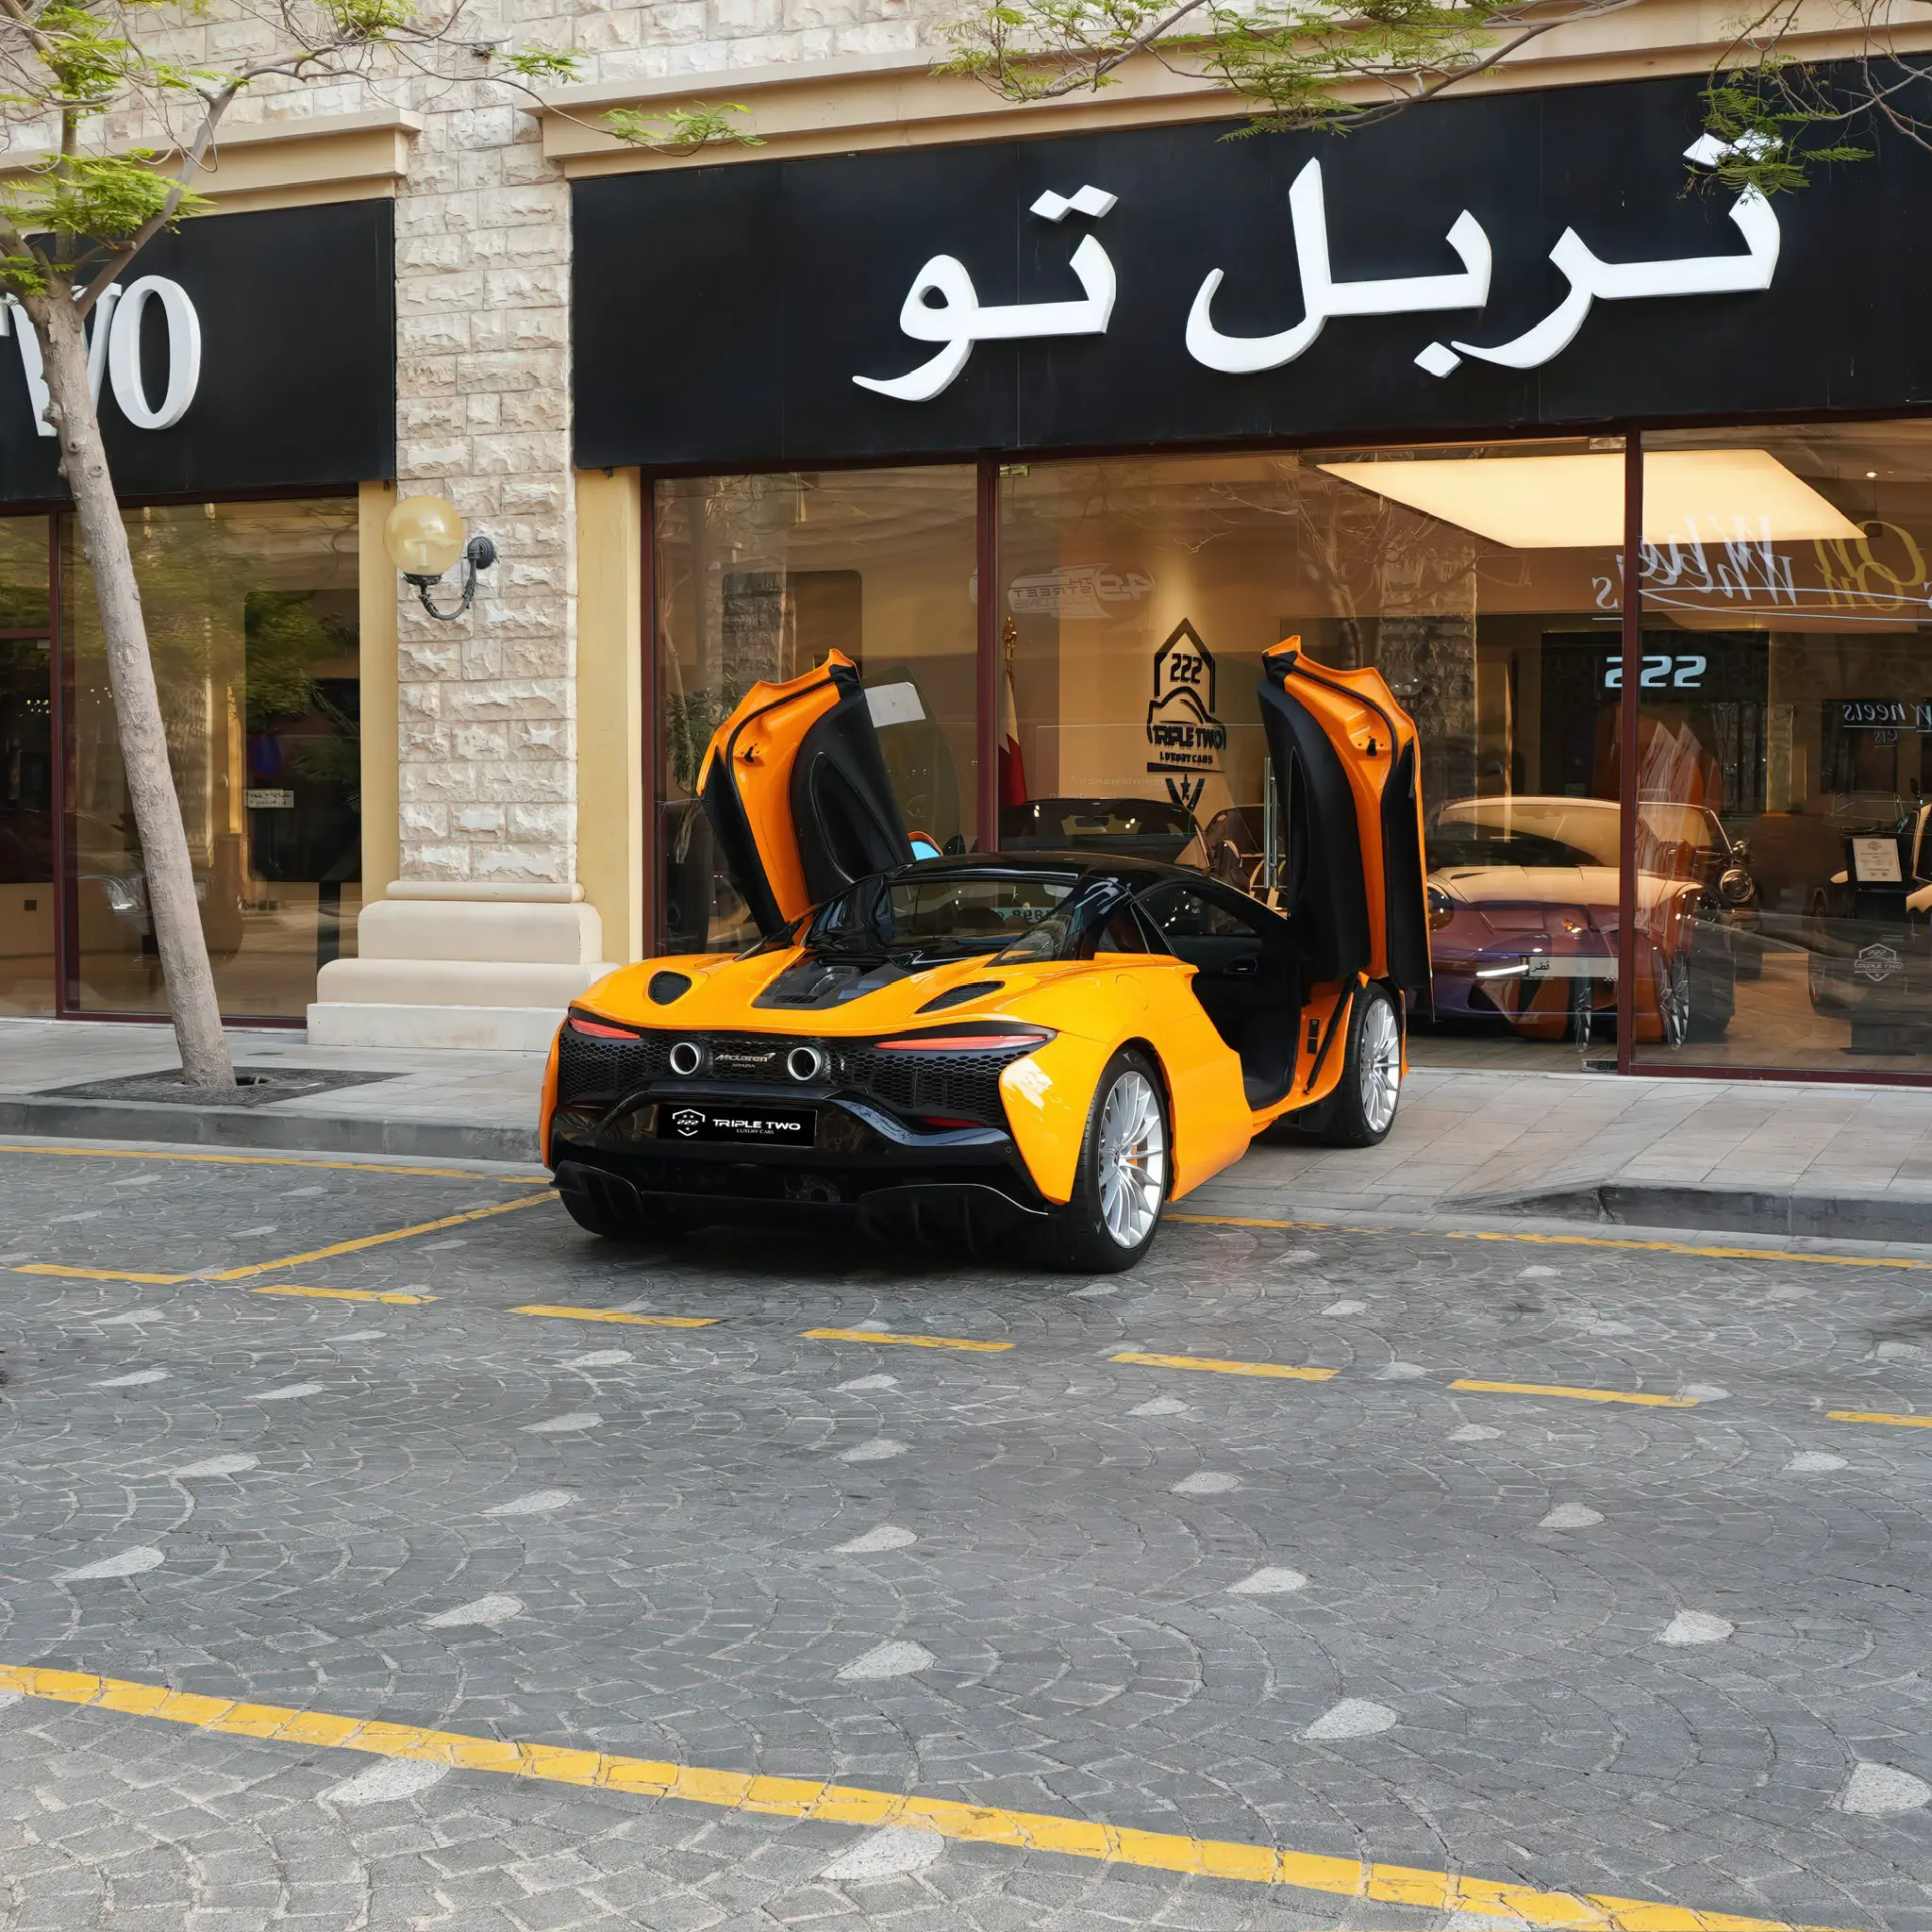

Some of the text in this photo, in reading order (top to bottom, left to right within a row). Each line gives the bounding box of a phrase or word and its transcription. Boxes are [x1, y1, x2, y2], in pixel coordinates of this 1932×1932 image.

[852, 128, 1783, 403] تربل تو
[0, 275, 201, 437] WO
[1170, 653, 1203, 684] 222
[1153, 724, 1224, 750] TRIPLE TWO
[1531, 960, 1550, 973] قطر
[712, 1119, 801, 1131] TRIPLE TWO
